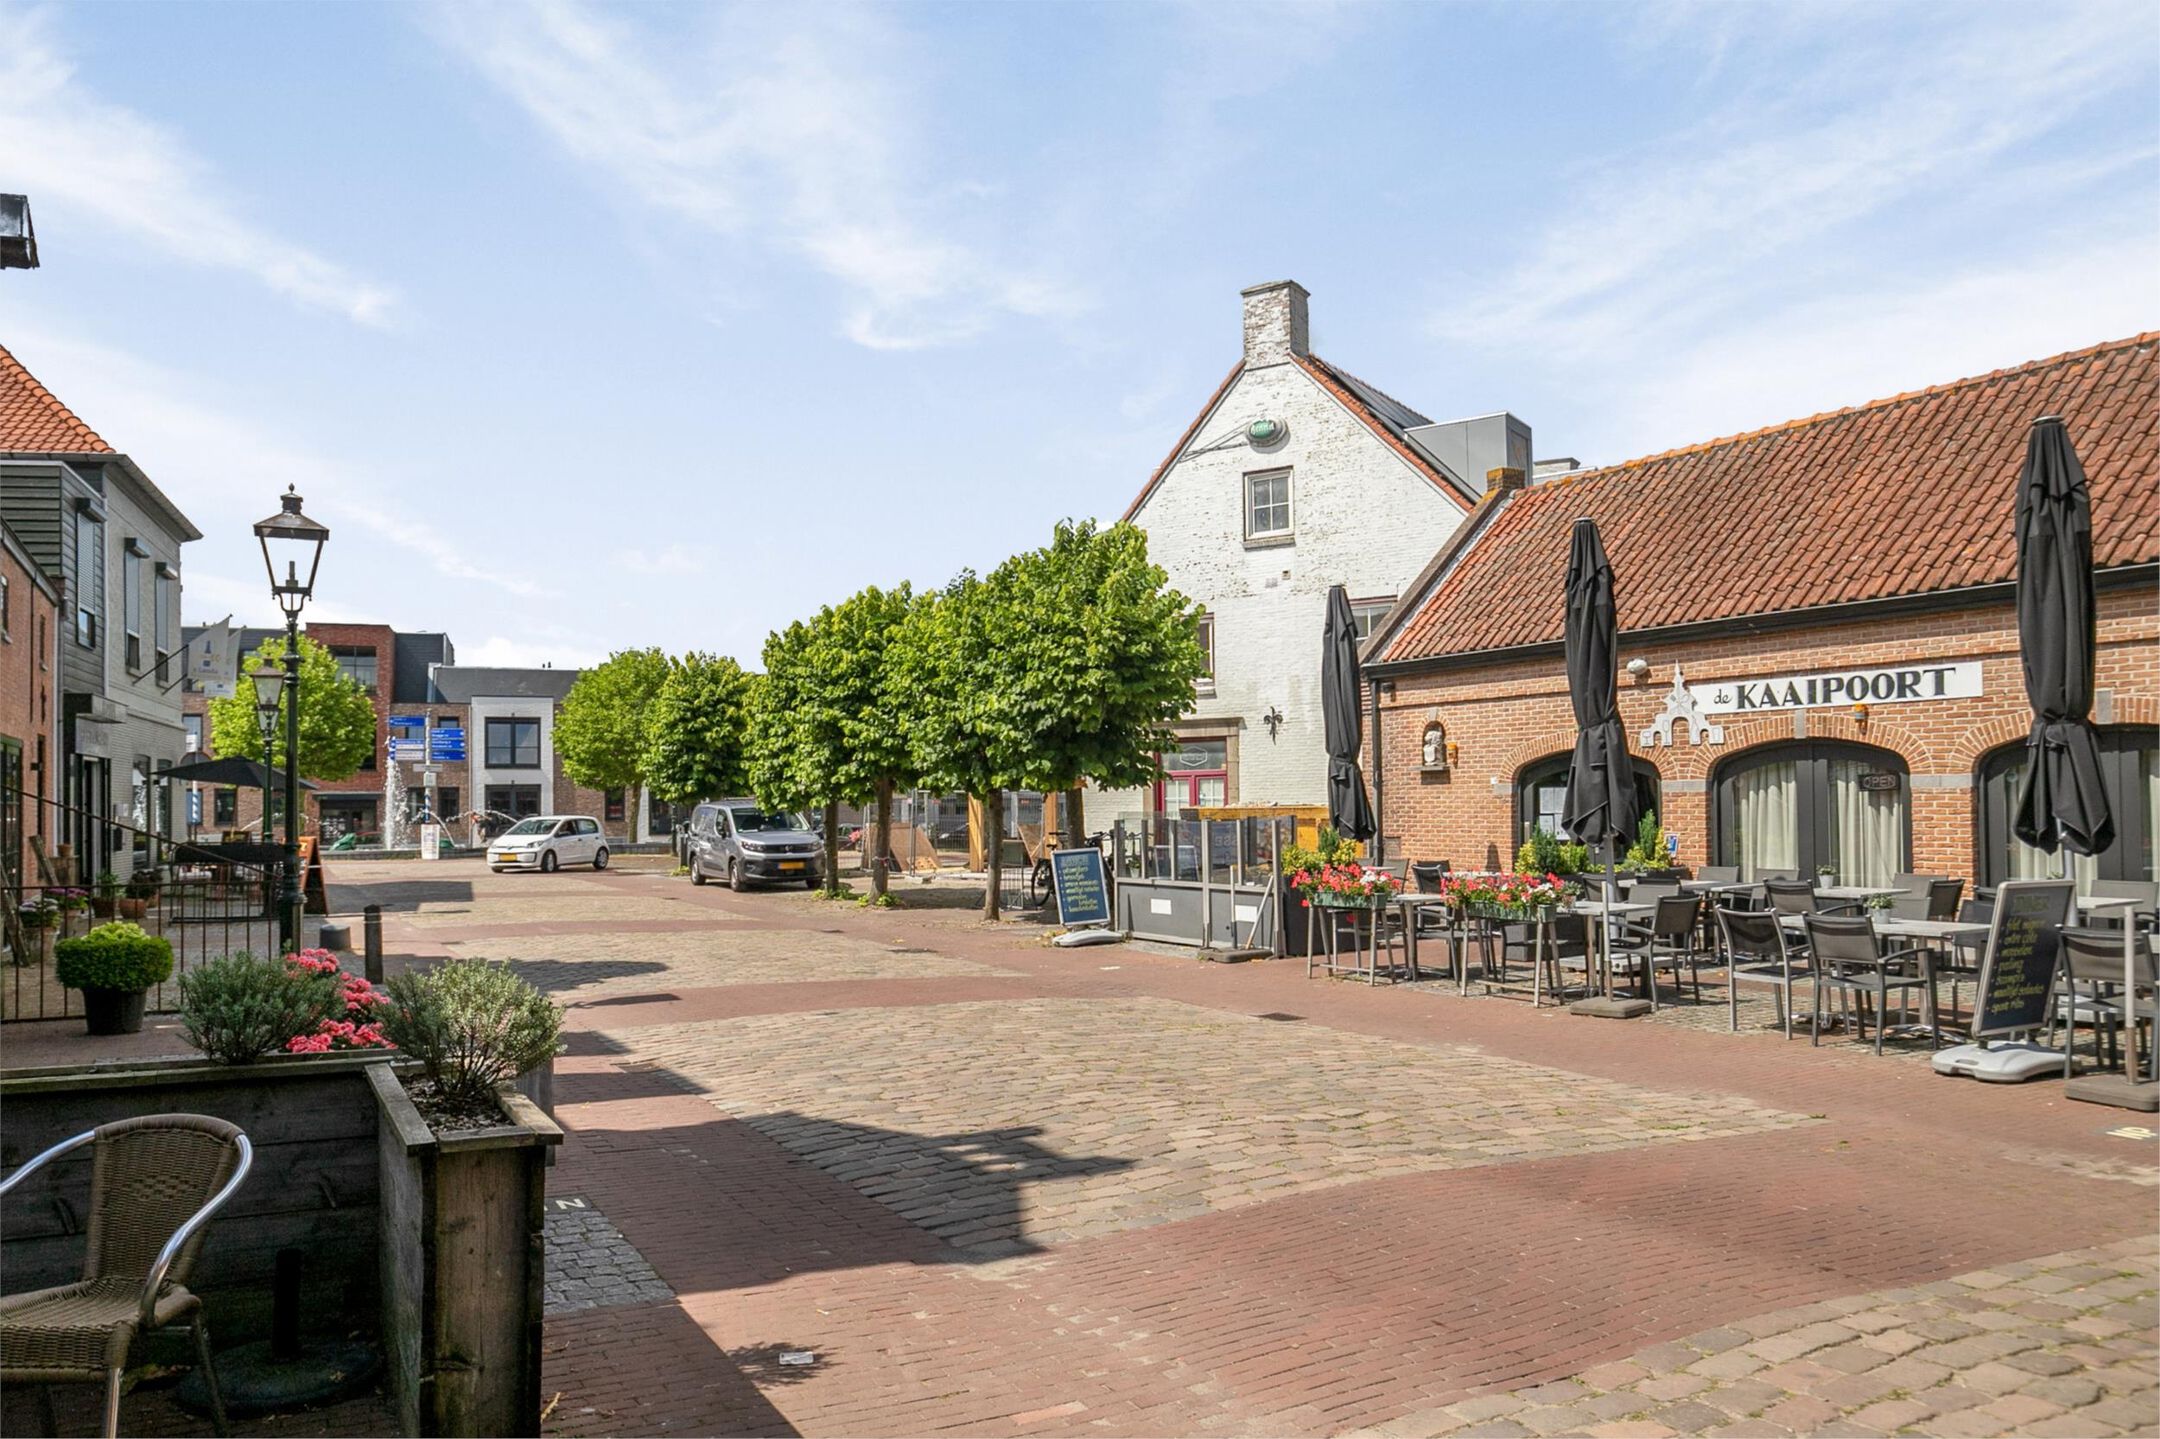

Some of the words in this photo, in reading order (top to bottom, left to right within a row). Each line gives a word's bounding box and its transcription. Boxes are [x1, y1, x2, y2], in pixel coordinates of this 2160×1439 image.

[1713, 688, 1733, 704] de
[1736, 667, 1956, 710] KAAIPOORT
[1863, 775, 1896, 788] OPEN
